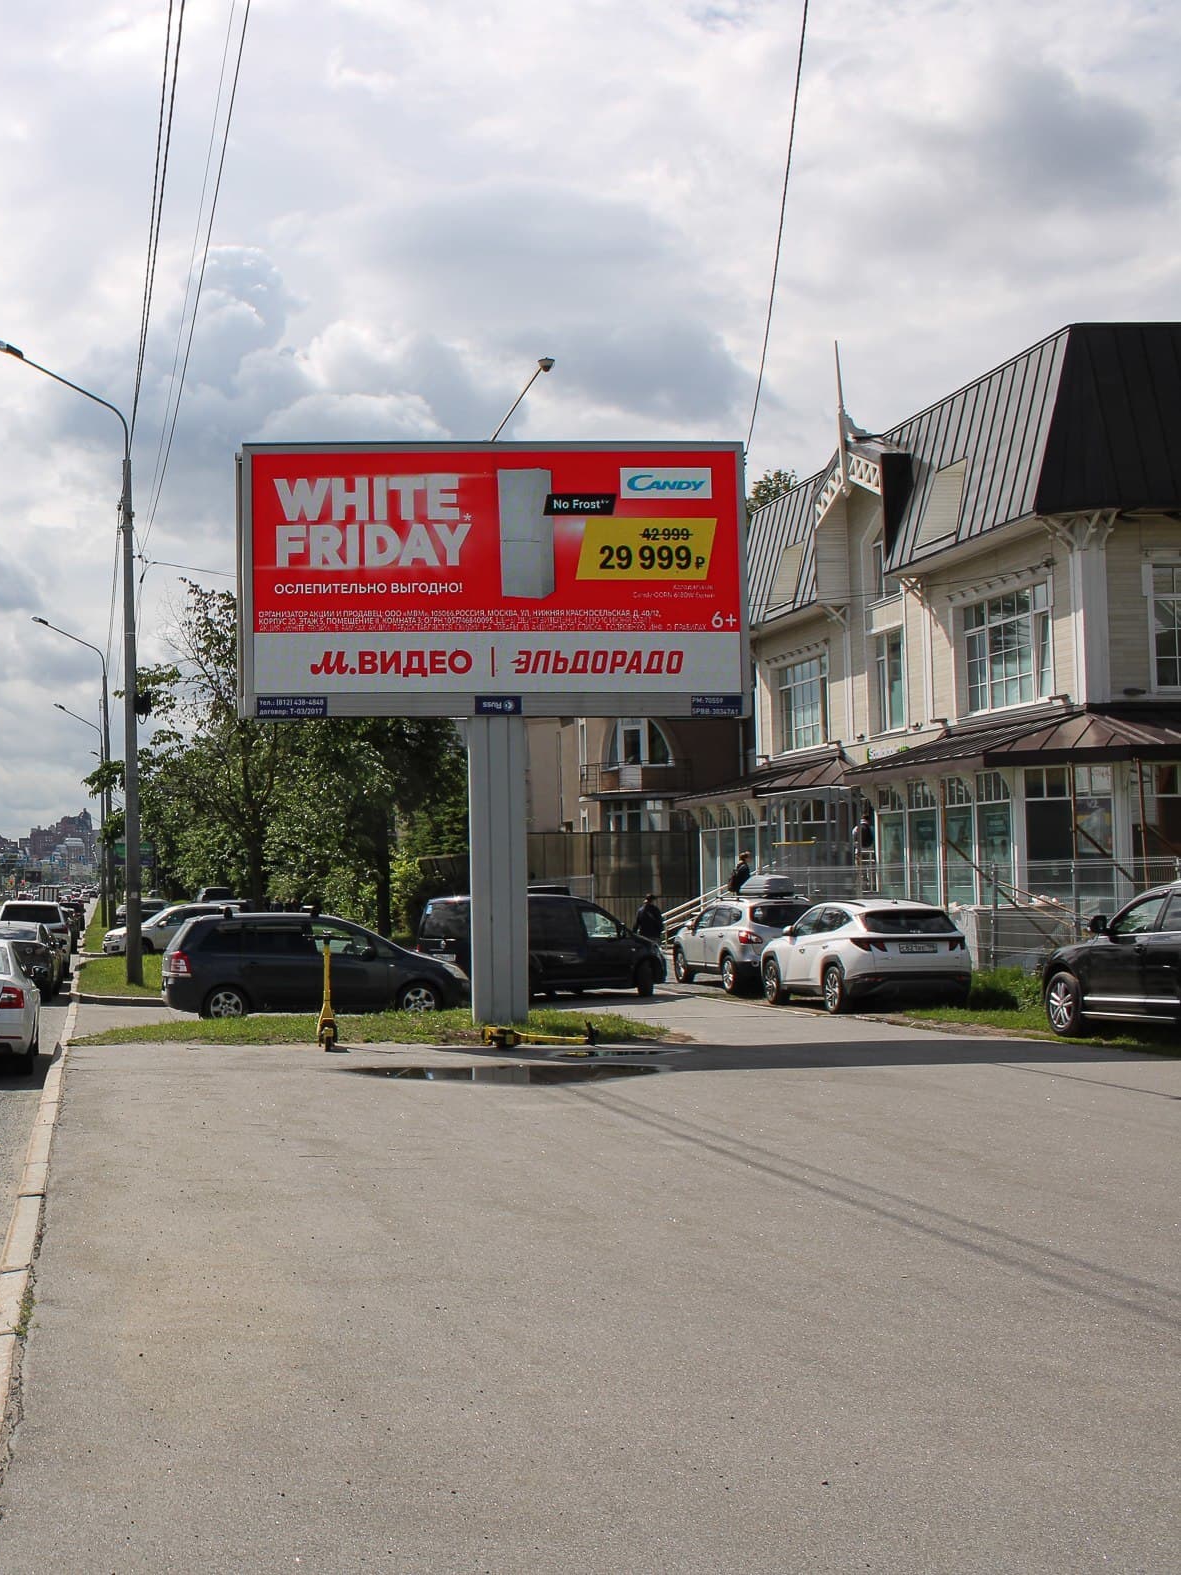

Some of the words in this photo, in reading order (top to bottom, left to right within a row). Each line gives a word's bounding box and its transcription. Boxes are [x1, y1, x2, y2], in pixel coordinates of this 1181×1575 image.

[626, 474, 706, 491] CANDY
[273, 473, 460, 522] WHITE
[553, 499, 569, 509] No
[275, 522, 472, 570] FRIDAY
[599, 544, 633, 570] 29
[638, 544, 692, 570] 999
[274, 582, 388, 595] ОСЛЕПИТЕЛЬНО
[390, 581, 464, 596] ВЫГОДНО!
[711, 610, 737, 629] 6+
[510, 649, 684, 674] ЭЛЬДОРАДО
